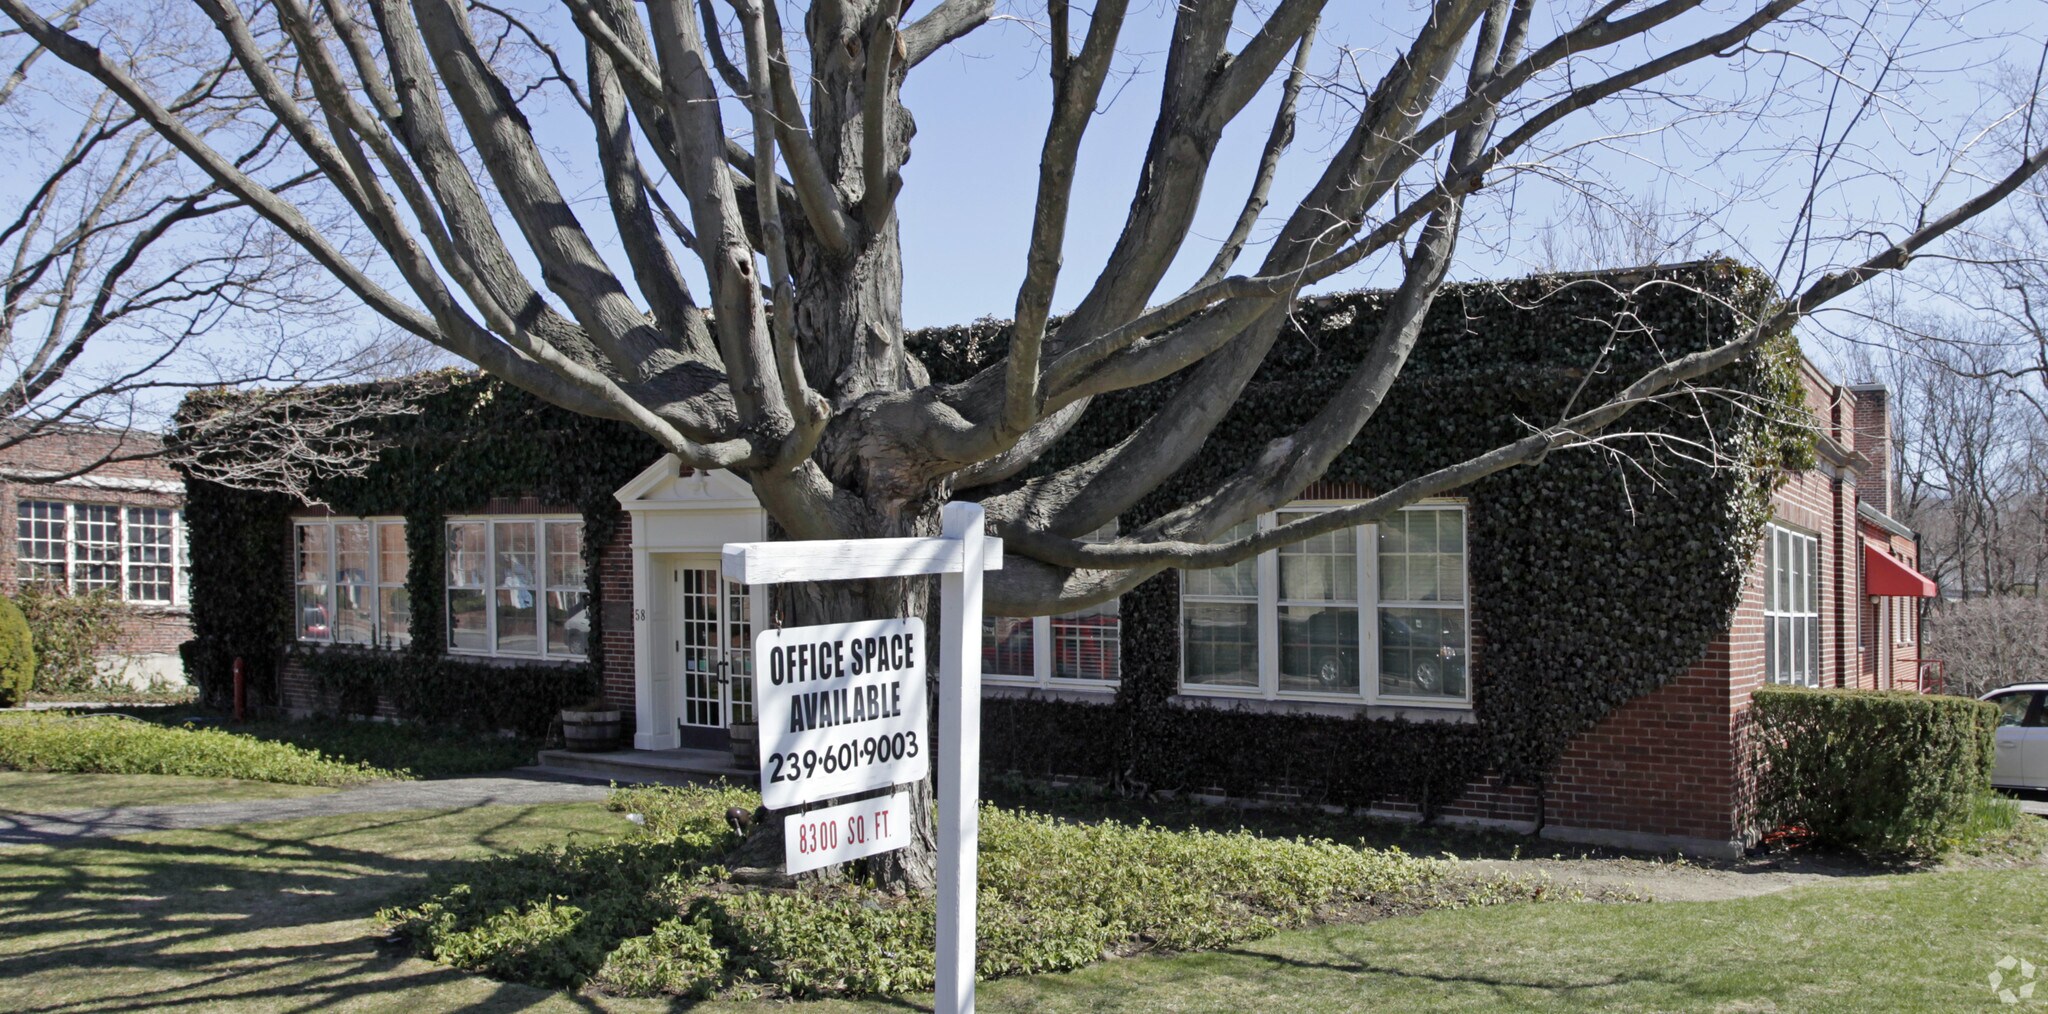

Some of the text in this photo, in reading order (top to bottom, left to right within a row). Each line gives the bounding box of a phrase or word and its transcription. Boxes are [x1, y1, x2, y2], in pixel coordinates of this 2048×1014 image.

[635, 609, 646, 621] 58
[770, 633, 914, 686] OFFICE SPACE
[790, 681, 901, 733] AVAILABLE
[848, 815, 870, 845] SQ.
[875, 810, 892, 839] FT.
